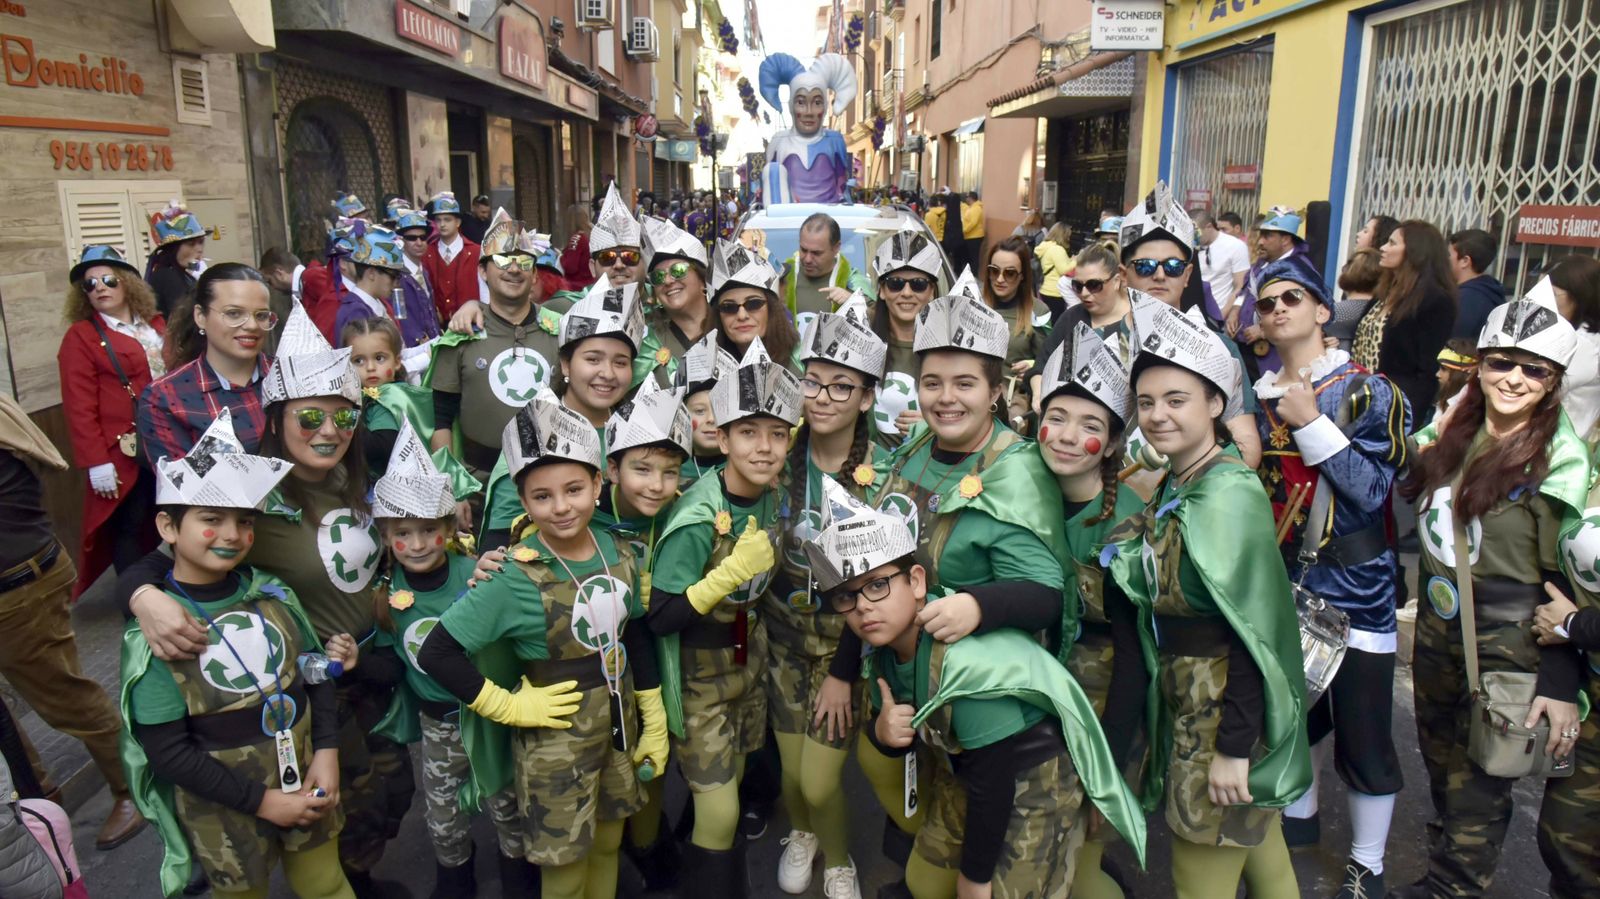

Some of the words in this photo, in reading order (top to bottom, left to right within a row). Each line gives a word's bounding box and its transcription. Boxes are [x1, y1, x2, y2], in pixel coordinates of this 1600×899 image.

[1115, 11, 1163, 20] SCHNEIDER
[0, 33, 145, 96] Domicilio
[49, 139, 94, 171] 956
[97, 142, 122, 171] 10
[1518, 216, 1560, 236] PRECIOS
